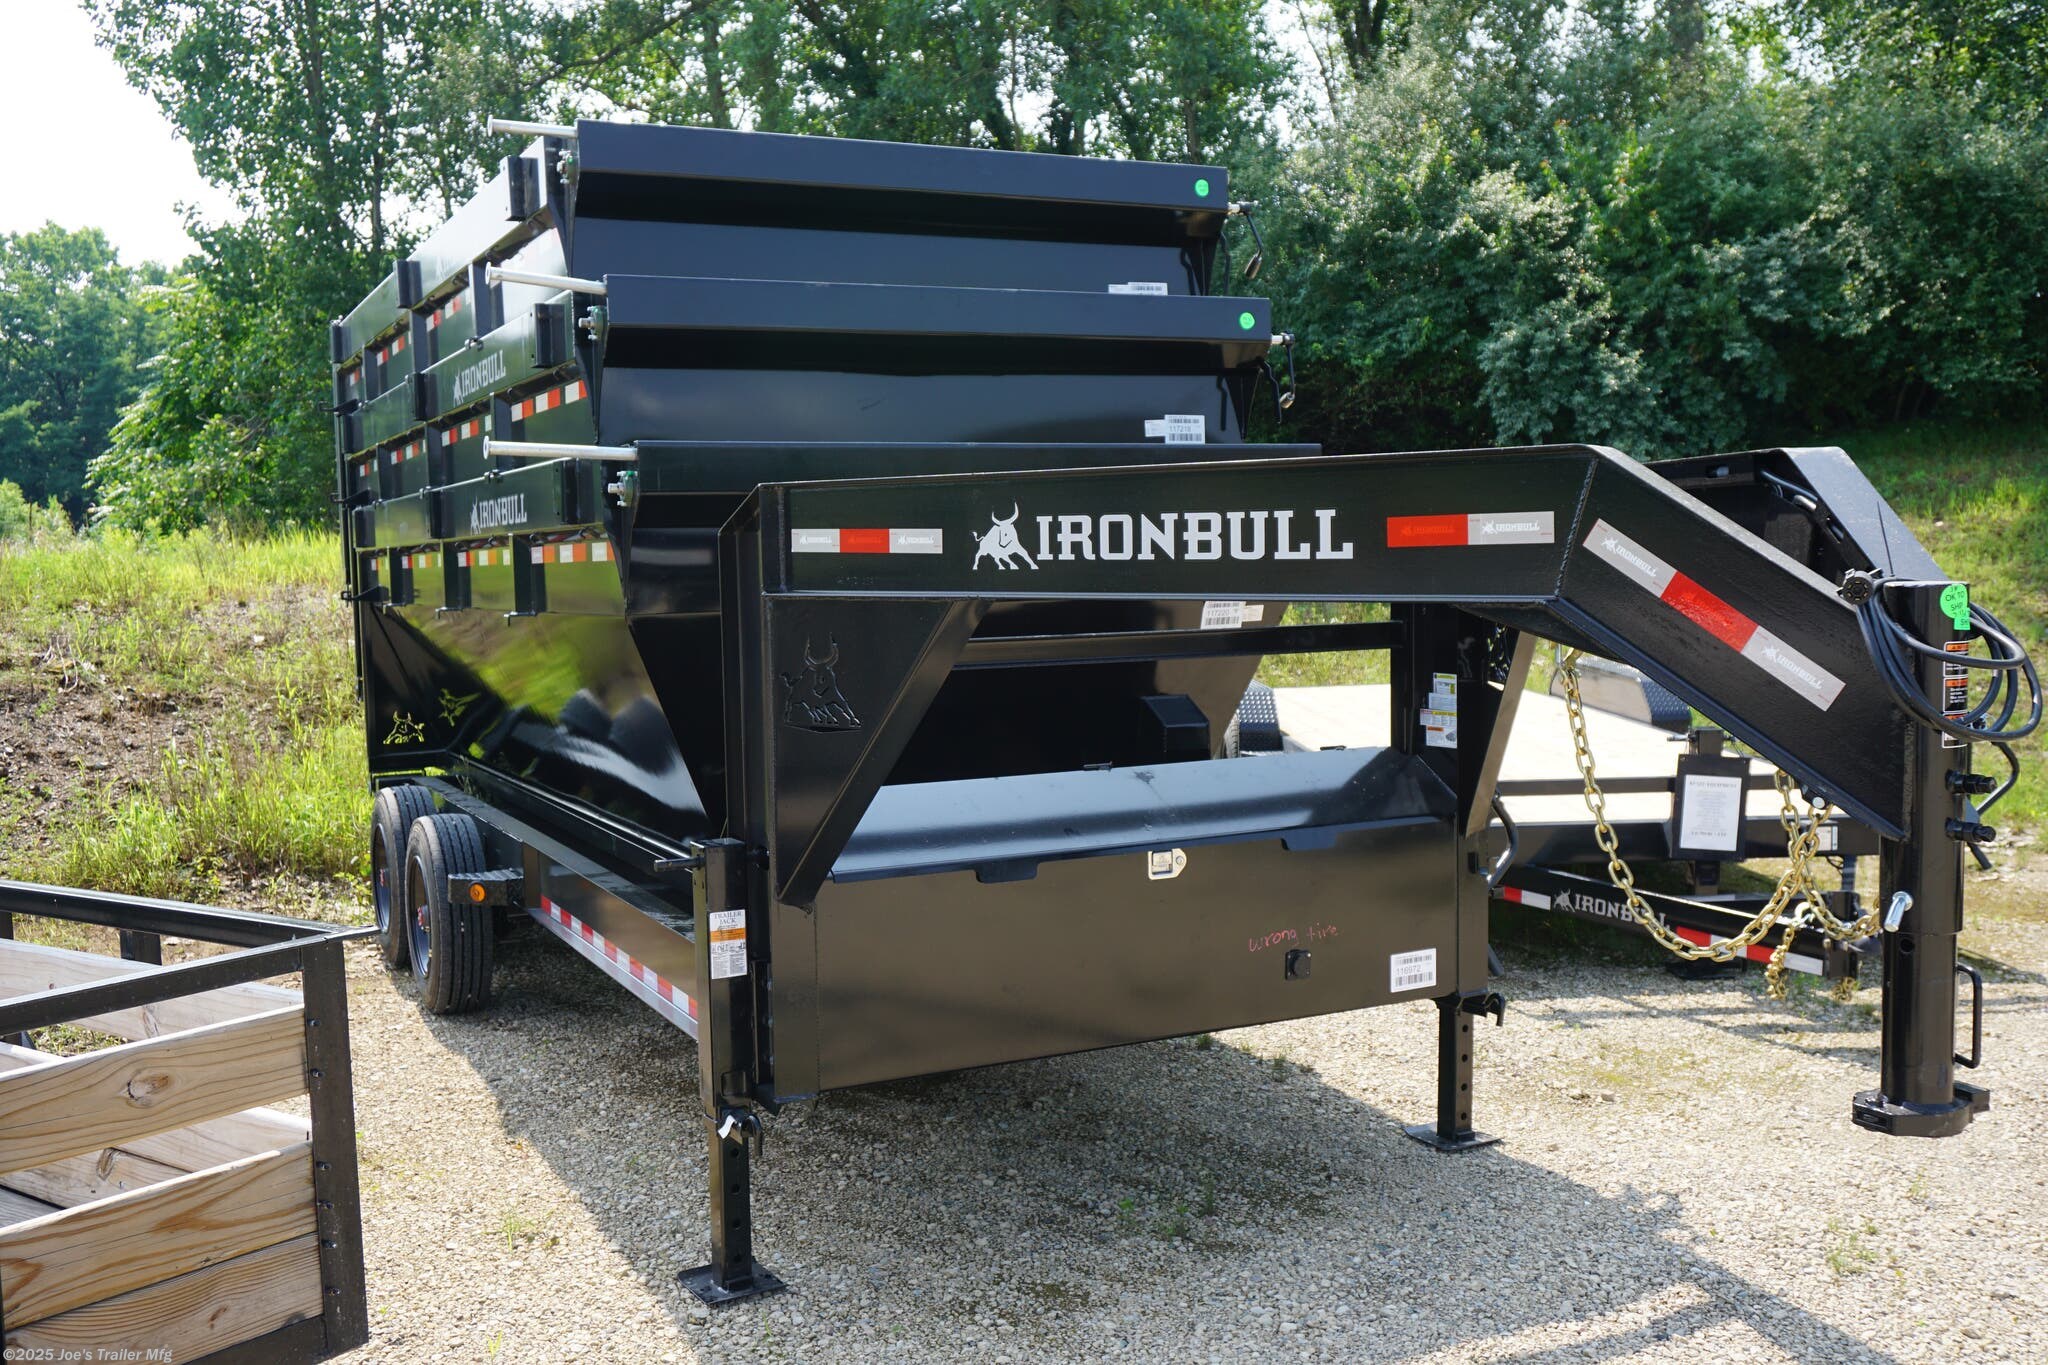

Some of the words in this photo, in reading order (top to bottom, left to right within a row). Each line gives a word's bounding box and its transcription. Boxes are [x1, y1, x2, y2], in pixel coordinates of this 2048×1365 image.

[461, 350, 506, 398] IRONBULL
[479, 493, 527, 528] IRONBULL
[1036, 509, 1353, 561] IRONBULL
[714, 911, 742, 919] TRAILER
[1575, 894, 1671, 930] IRONBL
[1249, 928, 1299, 952] wrong
[1307, 922, 1338, 942] tire
[1396, 965, 1421, 976] 116972
